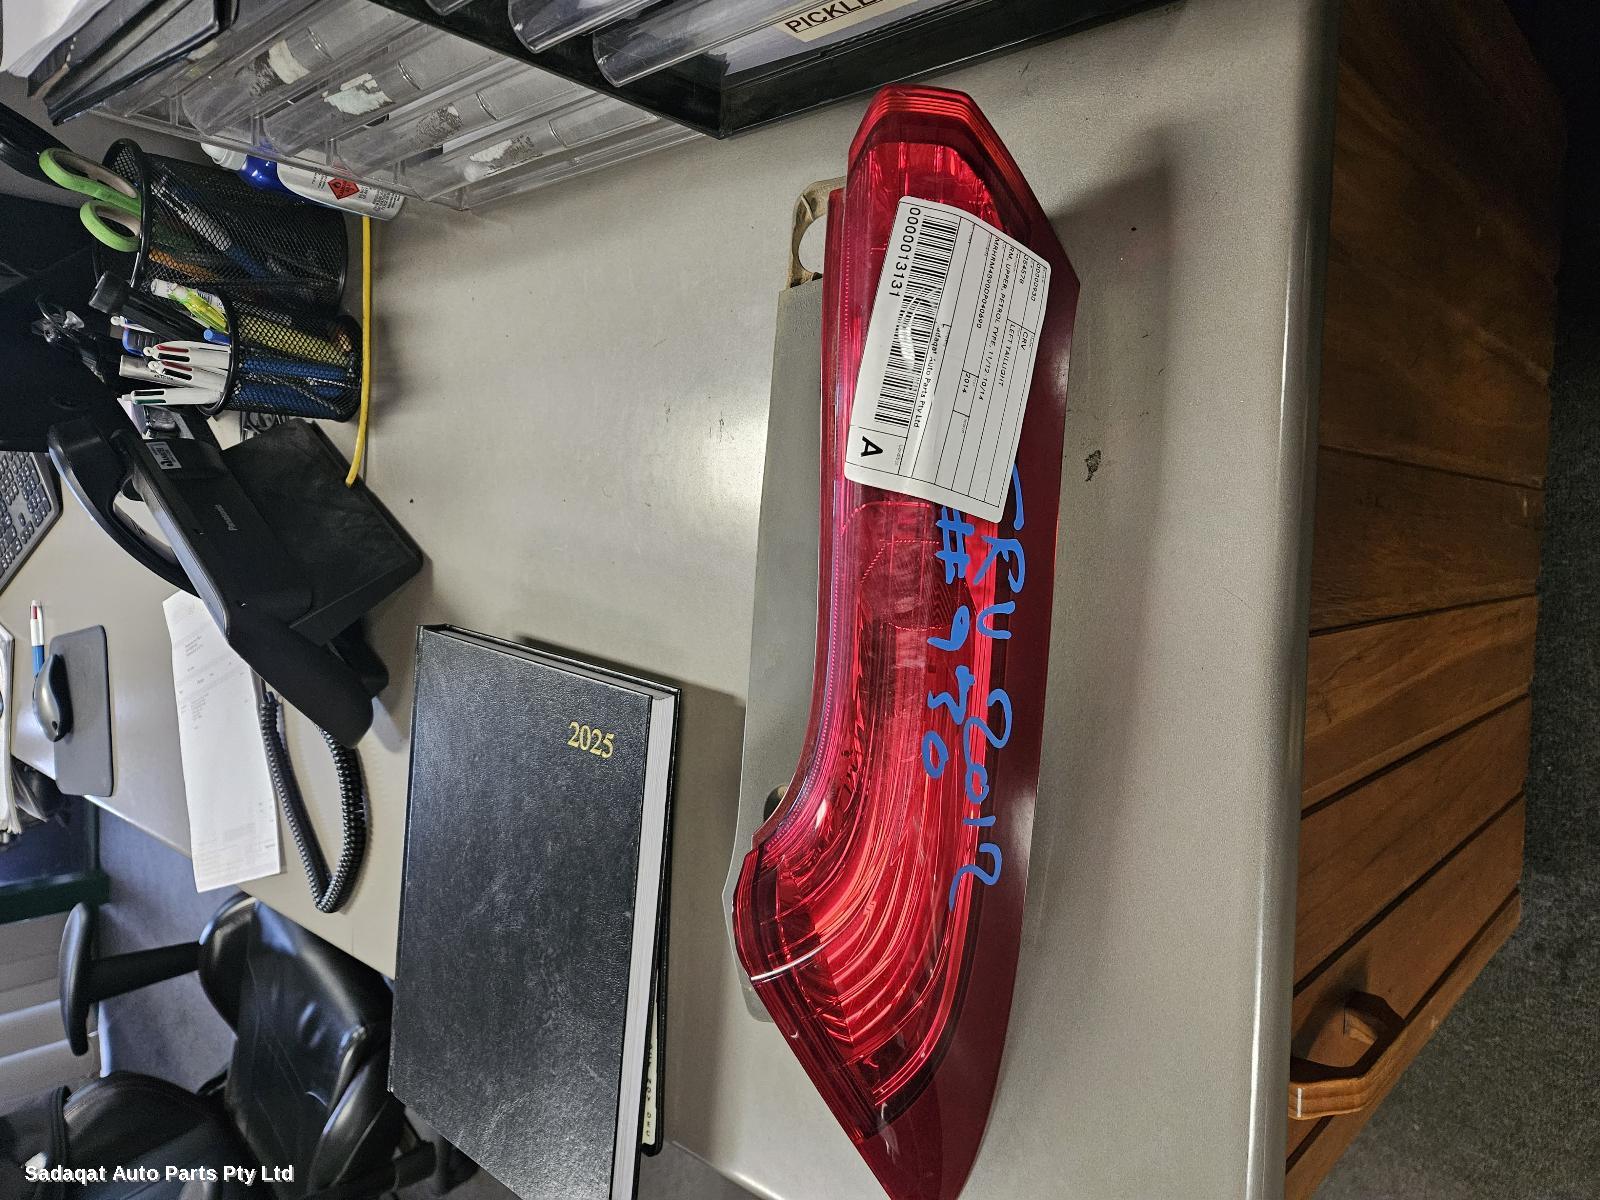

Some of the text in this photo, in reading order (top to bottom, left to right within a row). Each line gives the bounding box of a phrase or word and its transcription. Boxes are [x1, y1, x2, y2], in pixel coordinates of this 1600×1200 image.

[888, 206, 920, 297] 0000013131
[1000, 262, 1012, 291] UPPER,
[994, 292, 1006, 325] PETROL
[988, 325, 999, 348] TYPE,
[1020, 330, 1028, 350] CRV
[925, 356, 936, 376] Auto
[997, 323, 1016, 387] LEFT TAILLIGHT
[919, 377, 931, 399] Parts
[961, 372, 971, 393] 2014
[912, 414, 922, 428] Ltd
[860, 435, 883, 457] A
[567, 721, 615, 759] 2025
